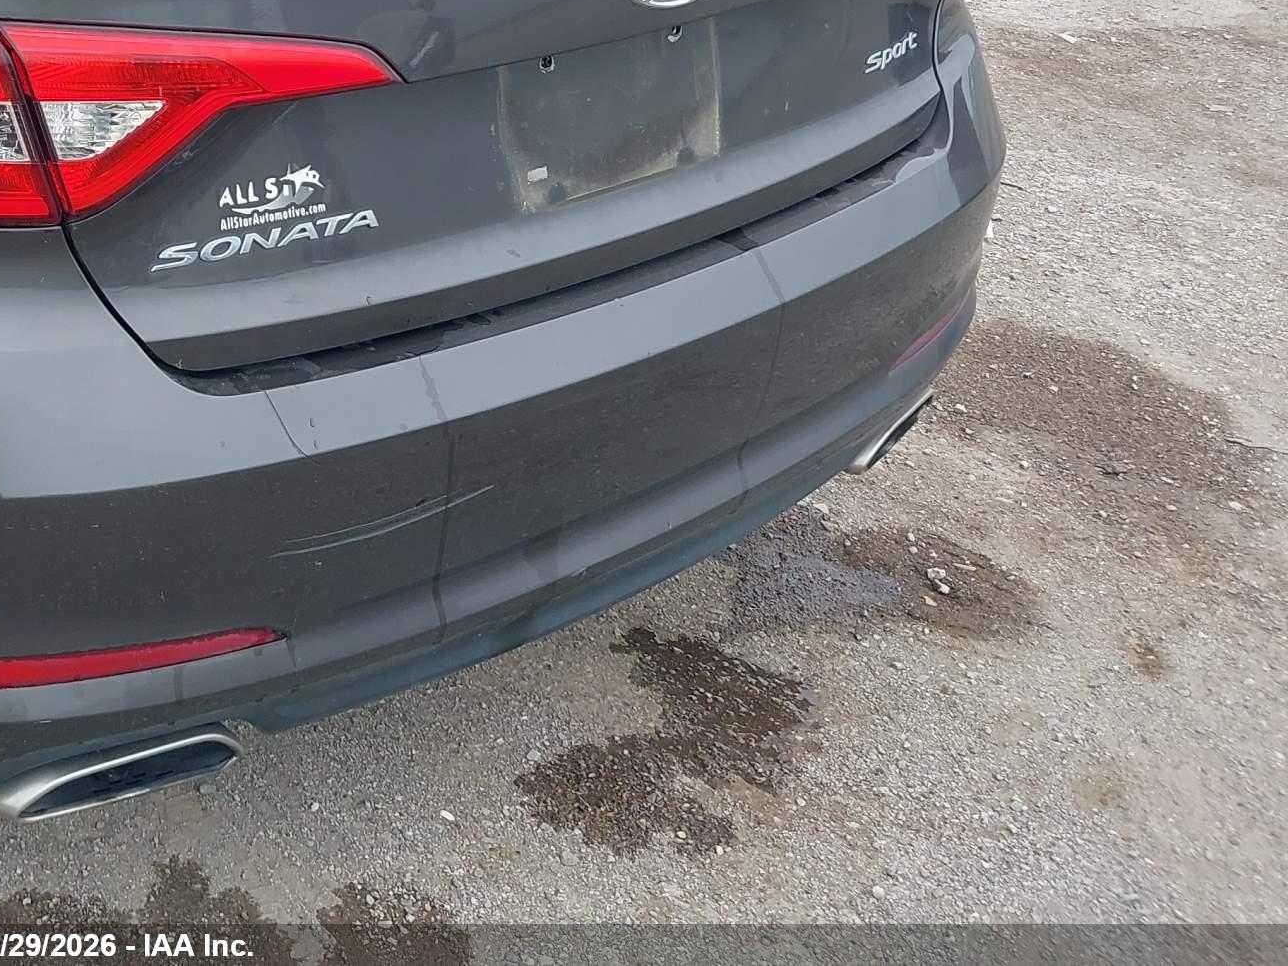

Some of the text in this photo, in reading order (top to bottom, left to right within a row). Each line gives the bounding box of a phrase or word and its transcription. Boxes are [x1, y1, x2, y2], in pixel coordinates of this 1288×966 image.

[865, 31, 918, 74] Sport
[219, 181, 260, 208] ALL
[220, 203, 327, 232] AllStarAutomotive.com
[150, 209, 380, 273] SONATA
